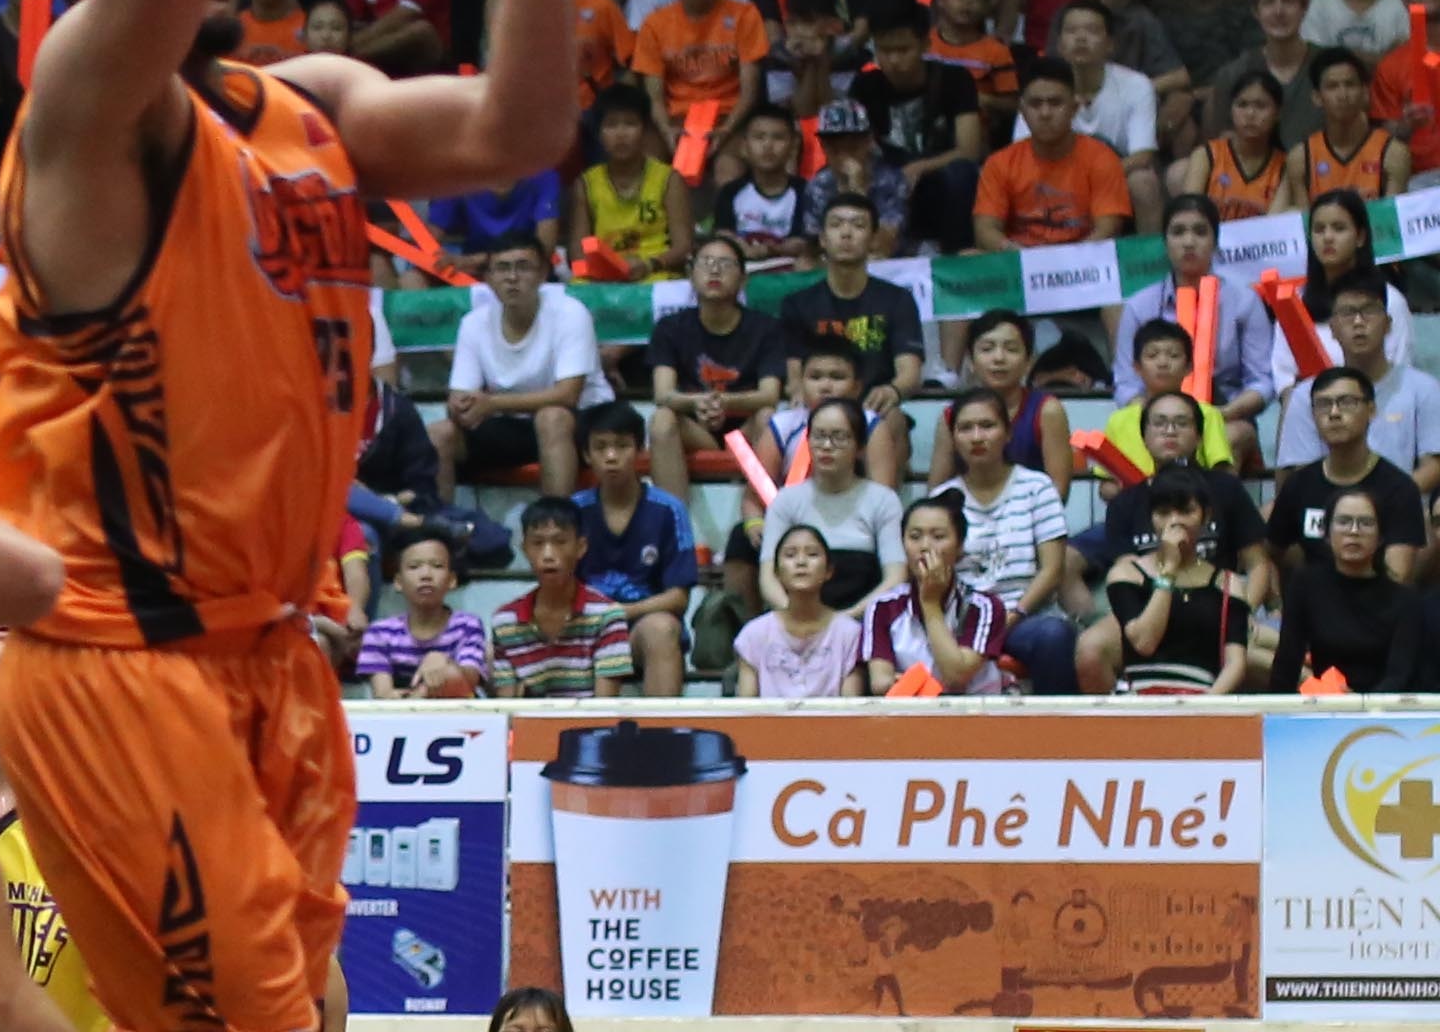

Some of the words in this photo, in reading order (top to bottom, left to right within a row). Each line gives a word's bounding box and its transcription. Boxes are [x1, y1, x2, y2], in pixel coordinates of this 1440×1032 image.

[638, 200, 657, 222] 15
[1217, 240, 1289, 265] STANDARD
[1293, 239, 1300, 256] 1
[1030, 269, 1101, 291] STANDARD
[1105, 266, 1112, 282] 1
[385, 737, 465, 786] LS
[770, 779, 866, 849] Cà
[898, 780, 1029, 849] Phê
[1058, 779, 1236, 849] Nhé!
[590, 888, 662, 911] WITH
[588, 918, 640, 941] THE
[586, 948, 700, 972] COFFEE
[1349, 940, 1440, 960] HOSPIT
[586, 978, 682, 1002] HOUSE
[1274, 981, 1440, 998] WWW.THIENNHANHO
